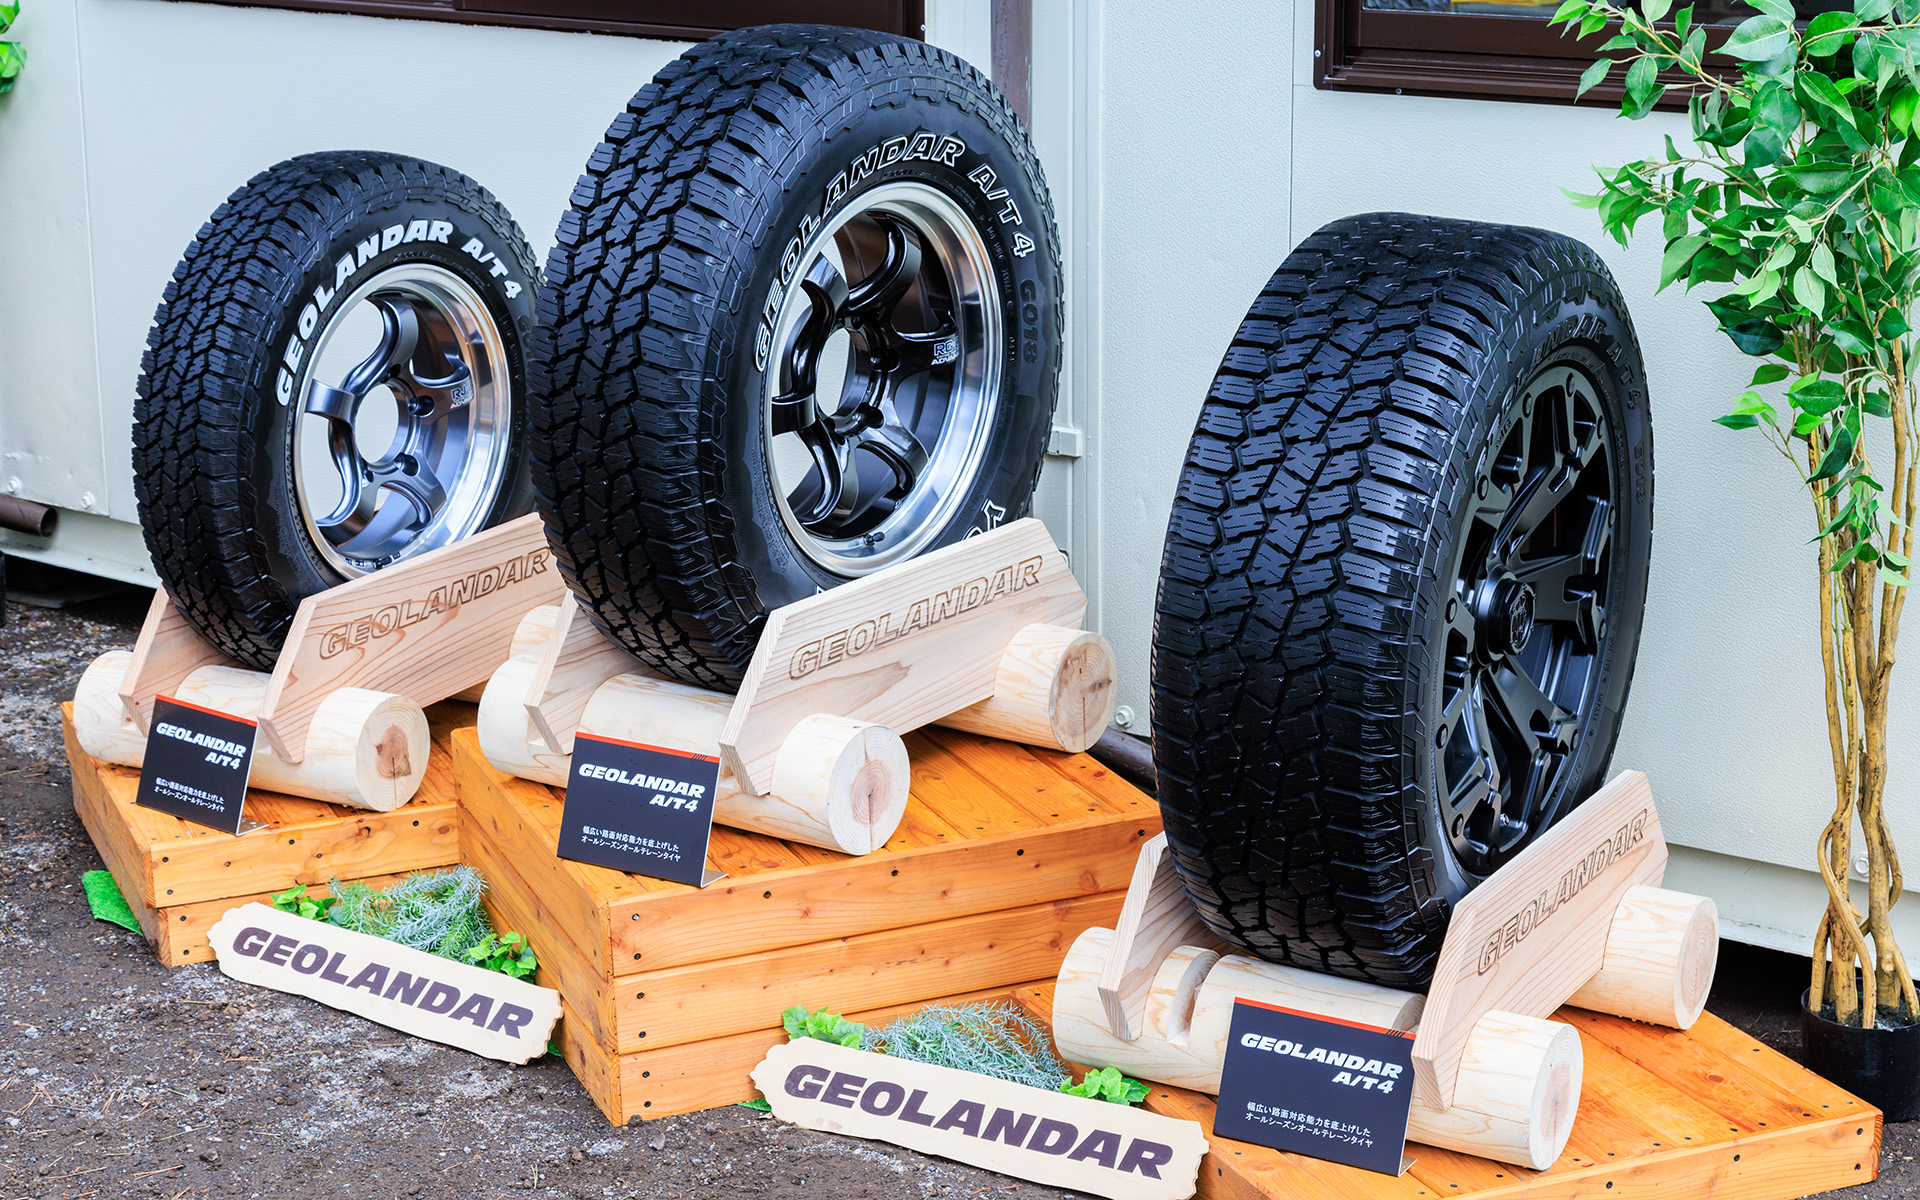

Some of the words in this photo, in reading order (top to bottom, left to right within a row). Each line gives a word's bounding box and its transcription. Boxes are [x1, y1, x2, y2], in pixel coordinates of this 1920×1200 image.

[755, 132, 966, 373] GEOLANDAR
[275, 218, 455, 408] GEOLANDAR
[318, 545, 551, 661] GEOLANDAR
[788, 554, 1043, 682] GEOLANDAR
[155, 721, 247, 758] GEOLANDAR
[204, 751, 242, 770] A/T4
[578, 763, 706, 799] GEOLANDAR
[649, 793, 699, 813] A/T4
[580, 834, 682, 863] オールシーズンオールテレーンタイヤ
[1477, 807, 1648, 977] GEOLANDAR
[232, 926, 535, 1040] GEOLANDAR
[1240, 1032, 1404, 1079] GEOLANDAR
[1331, 1071, 1395, 1095] A/T4
[783, 1064, 1174, 1181] GEOLANDAR
[1244, 1112, 1374, 1149] オールシーズンオールテレーンタイヤ
[1246, 1101, 1372, 1138] 幅広い路面対応能力を底上げした
